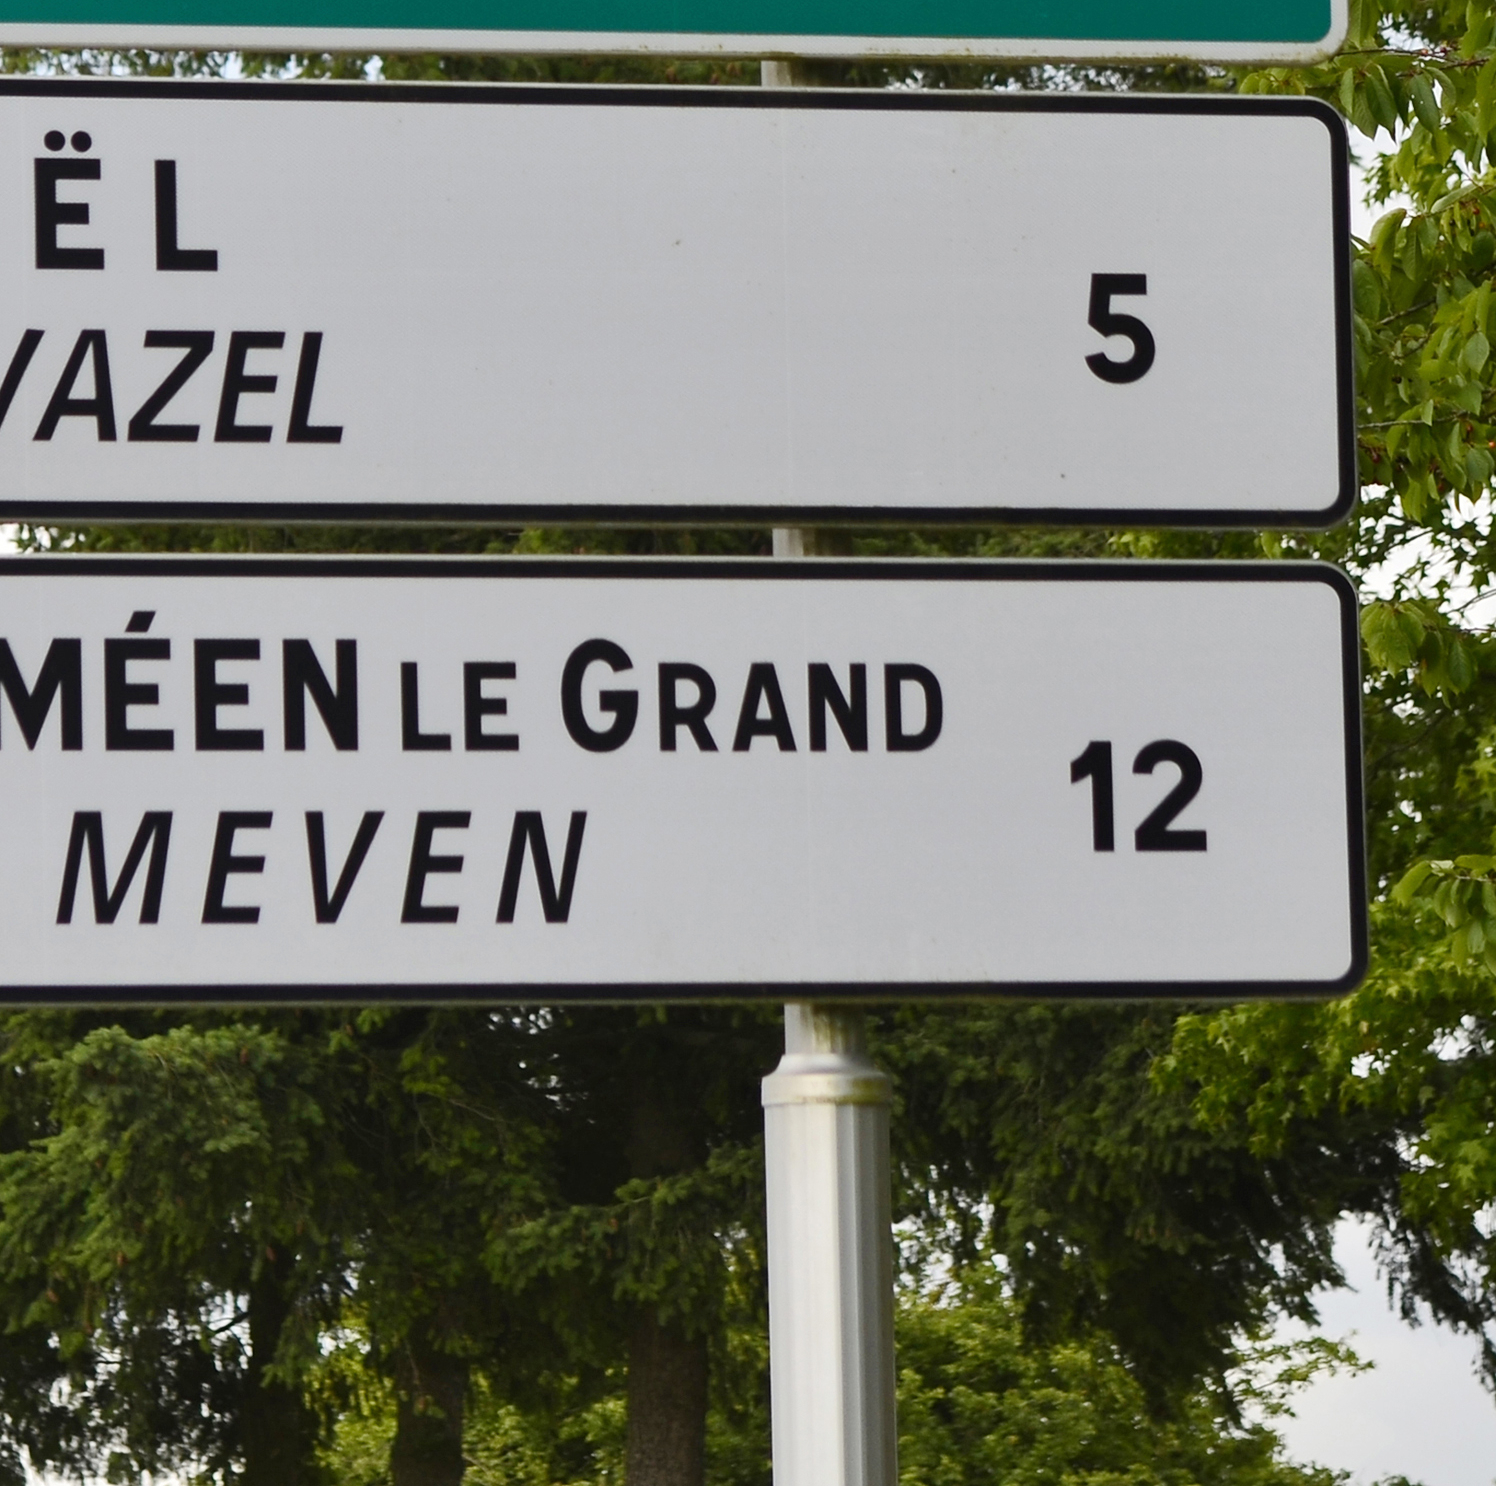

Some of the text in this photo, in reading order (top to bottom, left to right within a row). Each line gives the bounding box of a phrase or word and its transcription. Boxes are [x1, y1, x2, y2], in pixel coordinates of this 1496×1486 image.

[1085, 273, 1155, 384] 5
[401, 662, 519, 751] LE
[561, 639, 943, 752] GRAND
[1071, 740, 1207, 852] 12
[57, 811, 587, 924] MEVEN
